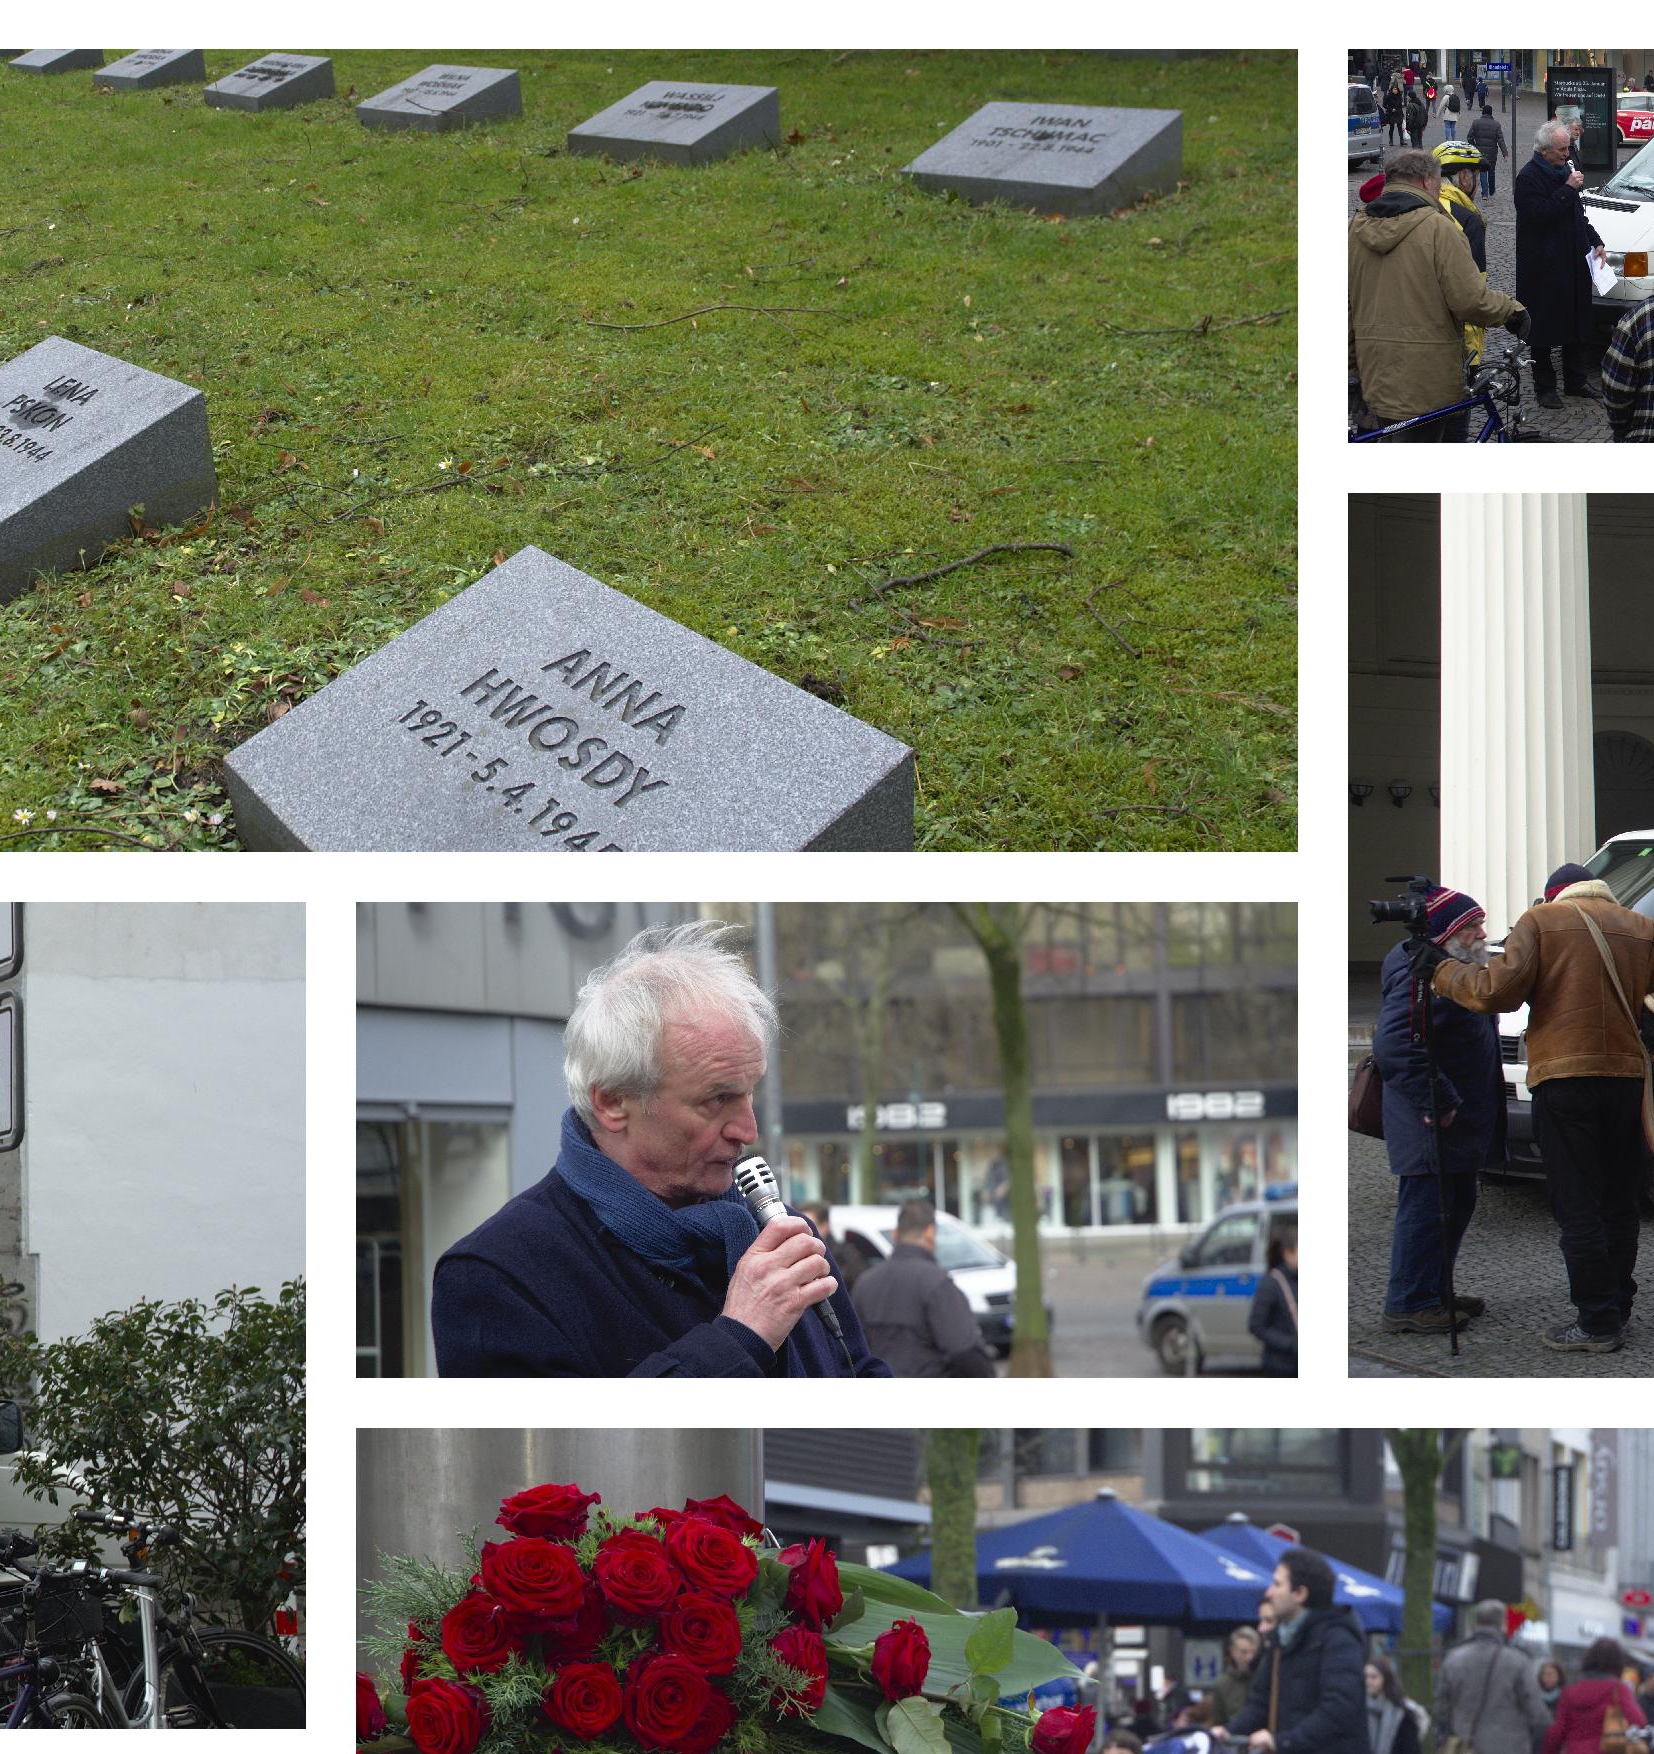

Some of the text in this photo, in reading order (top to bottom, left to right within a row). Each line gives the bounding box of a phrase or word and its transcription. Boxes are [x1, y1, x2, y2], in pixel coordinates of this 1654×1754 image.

[1030, 115, 1103, 128] IWAN
[42, 375, 99, 407] LENA
[540, 648, 687, 747] ANNA
[458, 667, 670, 809] HWOSDY
[1166, 1090, 1265, 1121] 1982
